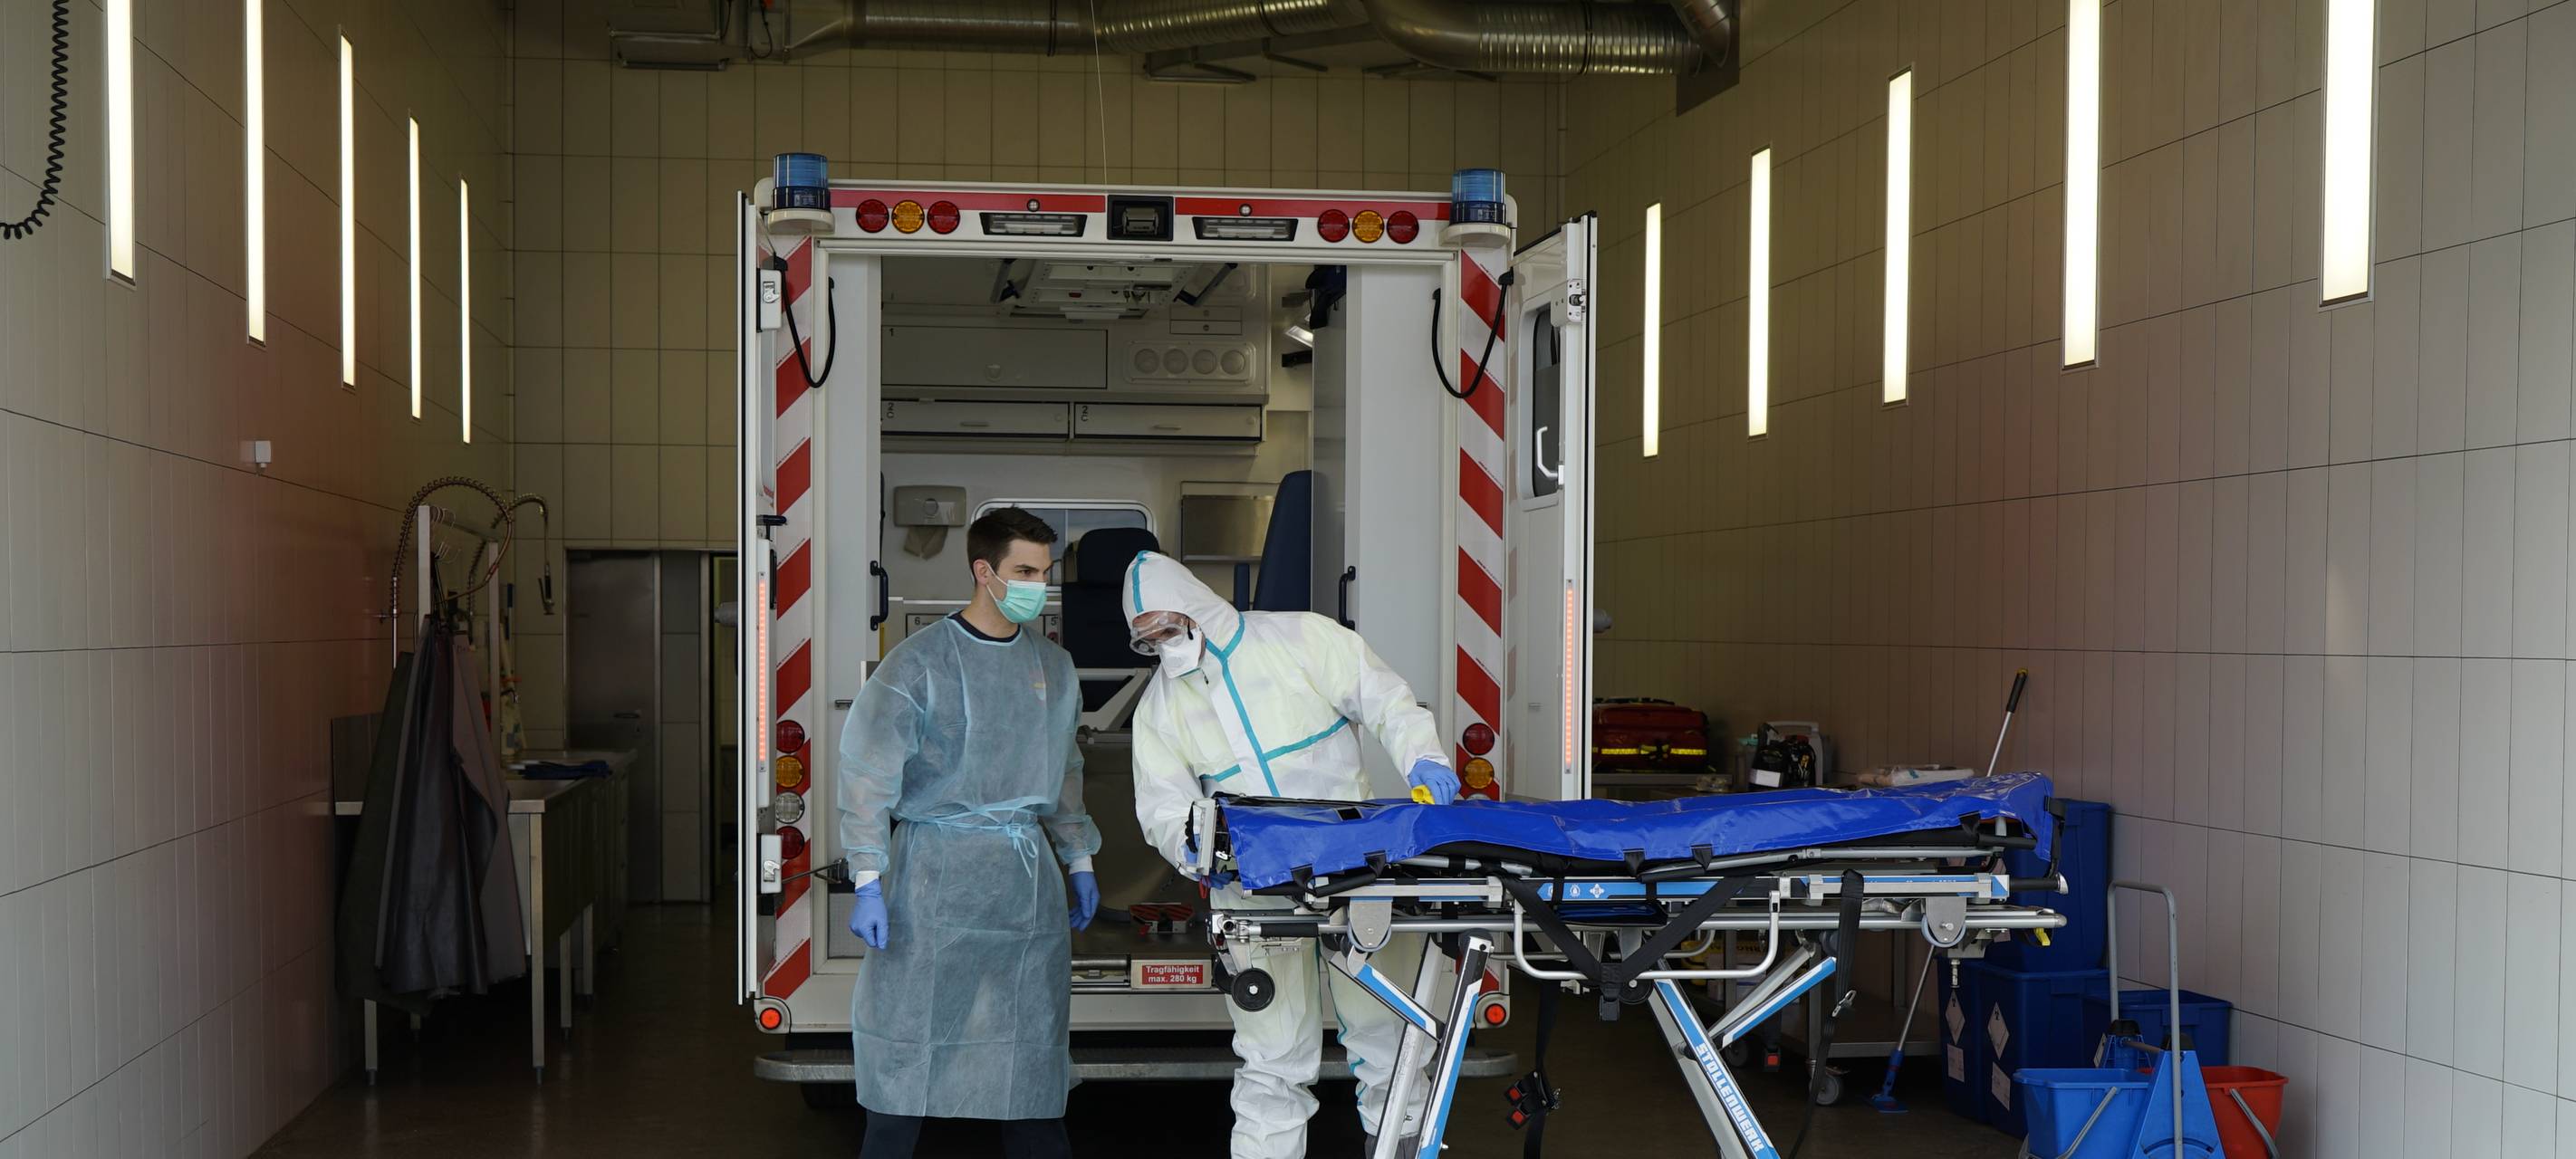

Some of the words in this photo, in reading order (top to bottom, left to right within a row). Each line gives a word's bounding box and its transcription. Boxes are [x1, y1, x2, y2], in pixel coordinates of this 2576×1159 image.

[889, 328, 894, 337] 1
[1081, 405, 1088, 414] 2
[914, 617, 921, 626] 6
[1051, 617, 1058, 626] 5
[1145, 965, 1199, 974] Tragfähigkeit
[1187, 975, 1197, 984] kg
[1696, 1042, 1765, 1153] STOLLENWERK
